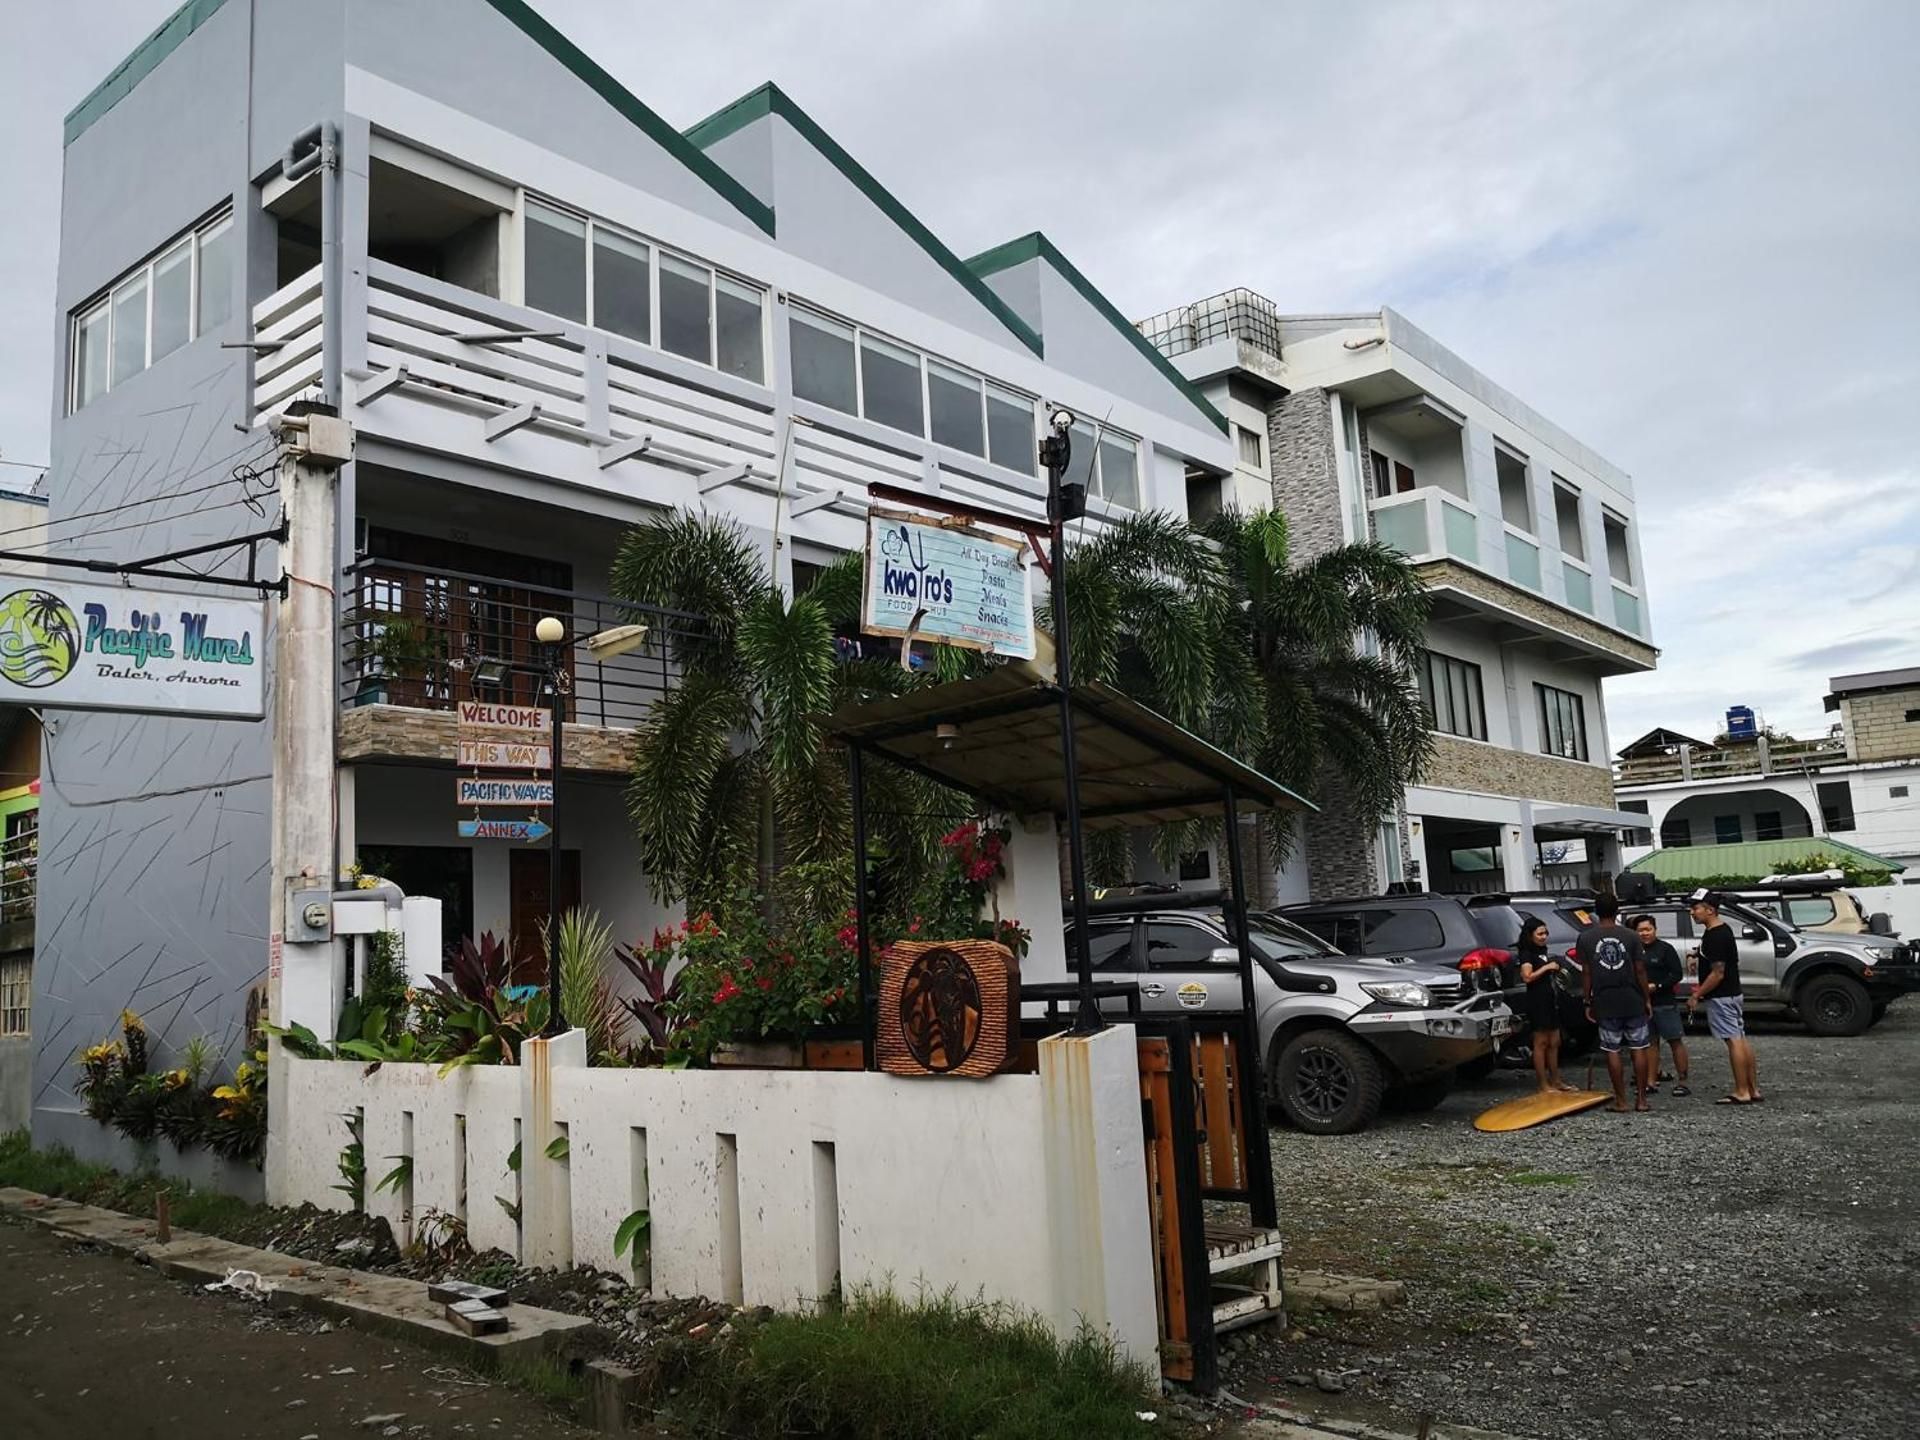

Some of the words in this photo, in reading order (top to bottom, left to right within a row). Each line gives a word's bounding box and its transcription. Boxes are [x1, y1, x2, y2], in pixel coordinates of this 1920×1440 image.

[981, 568, 1005, 588] Pasta
[887, 599, 914, 612] FOOD
[83, 602, 175, 668] Pacific
[180, 611, 254, 664] Waves
[96, 664, 159, 682] Baler,
[166, 670, 241, 687] Aurora
[462, 703, 543, 728] WELCOME
[462, 743, 499, 763] THIS
[505, 745, 540, 766] WAY
[461, 782, 511, 801] PACIFIC
[512, 783, 553, 801] WAVES
[474, 822, 529, 838] ANNEX
